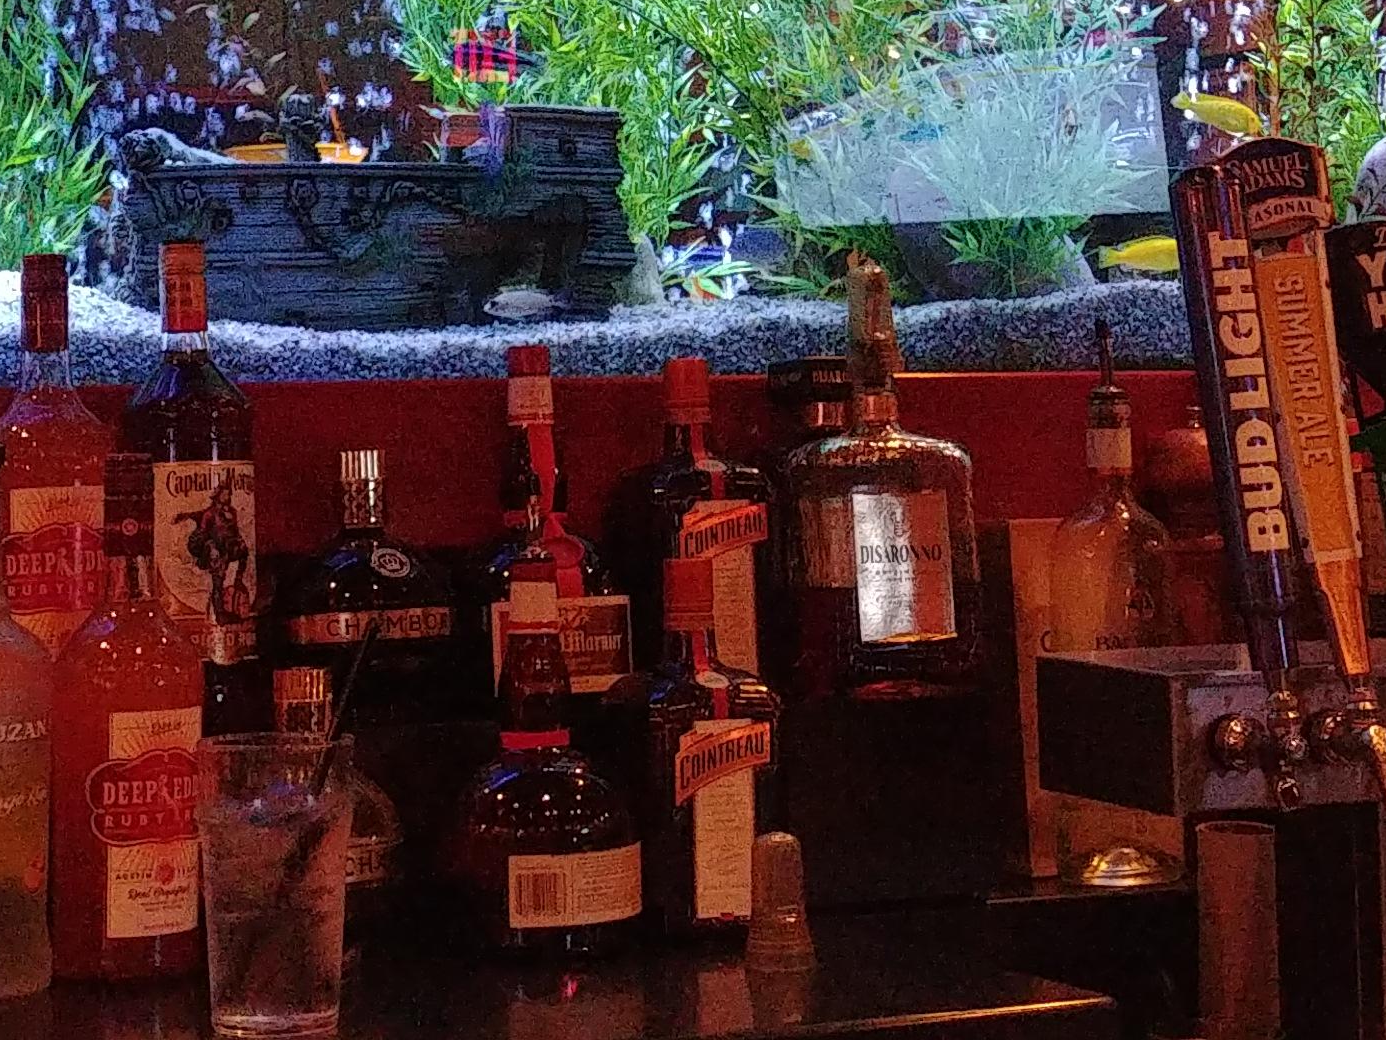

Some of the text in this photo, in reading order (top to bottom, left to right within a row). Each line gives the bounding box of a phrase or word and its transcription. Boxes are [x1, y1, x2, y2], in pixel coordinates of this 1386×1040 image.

[1253, 198, 1314, 223] ASONAL
[1274, 272, 1333, 467] SUMMER ALE
[1208, 232, 1290, 552] BUD LIGHT
[685, 512, 763, 559] COINTREAU
[6, 552, 55, 576] DEEP
[860, 544, 941, 565] DISARONNO
[680, 732, 763, 790] COINTREAU
[103, 778, 157, 805] DEEP
